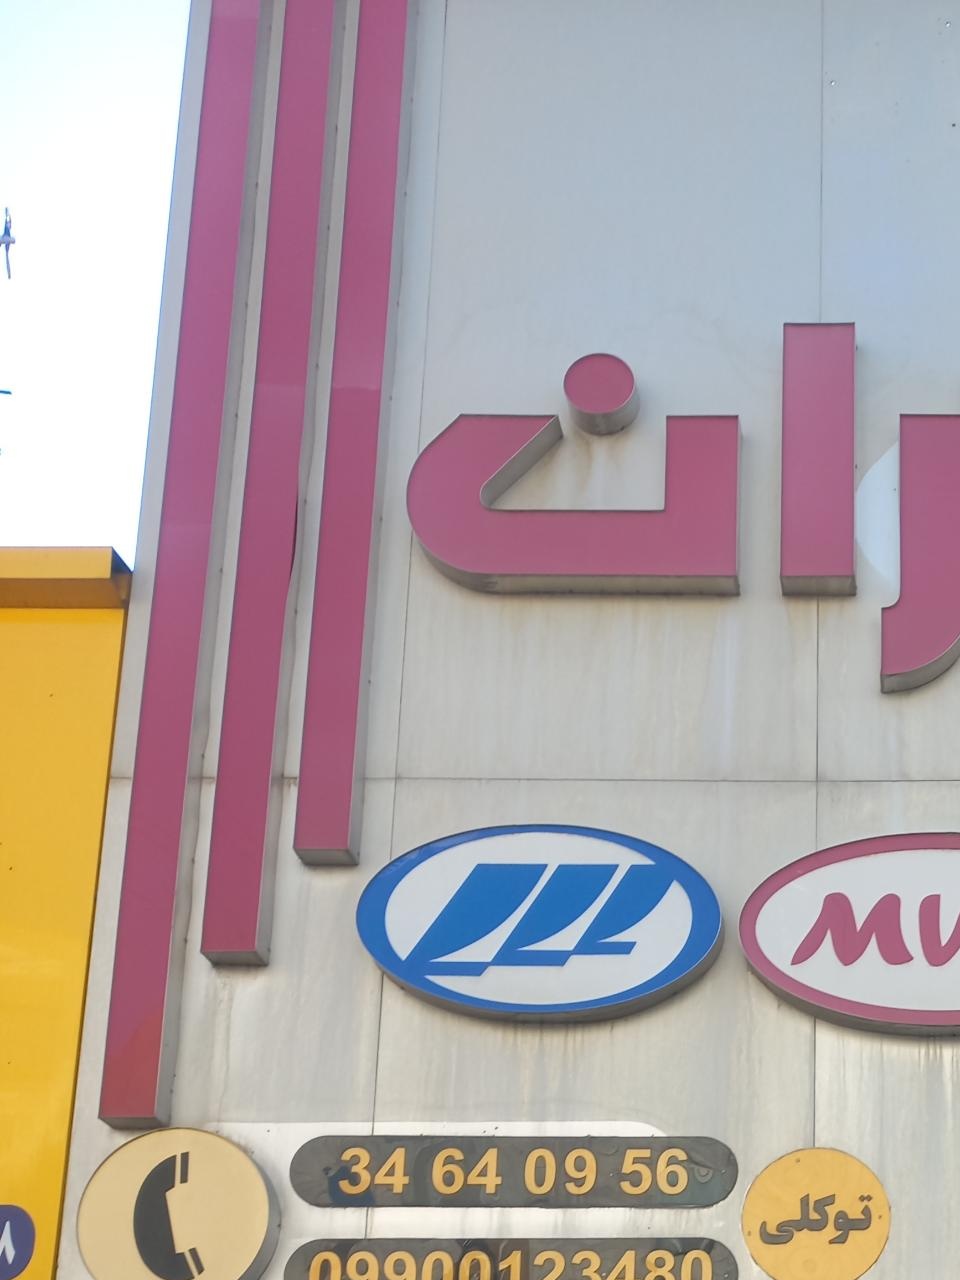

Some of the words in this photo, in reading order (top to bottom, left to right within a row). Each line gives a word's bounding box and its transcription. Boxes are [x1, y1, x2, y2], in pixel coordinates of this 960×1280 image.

[338, 1146, 410, 1196] 34
[431, 1147, 502, 1196] 64
[524, 1147, 597, 1196] 09
[619, 1147, 690, 1196] 56
[759, 1193, 873, 1245] توکلی
